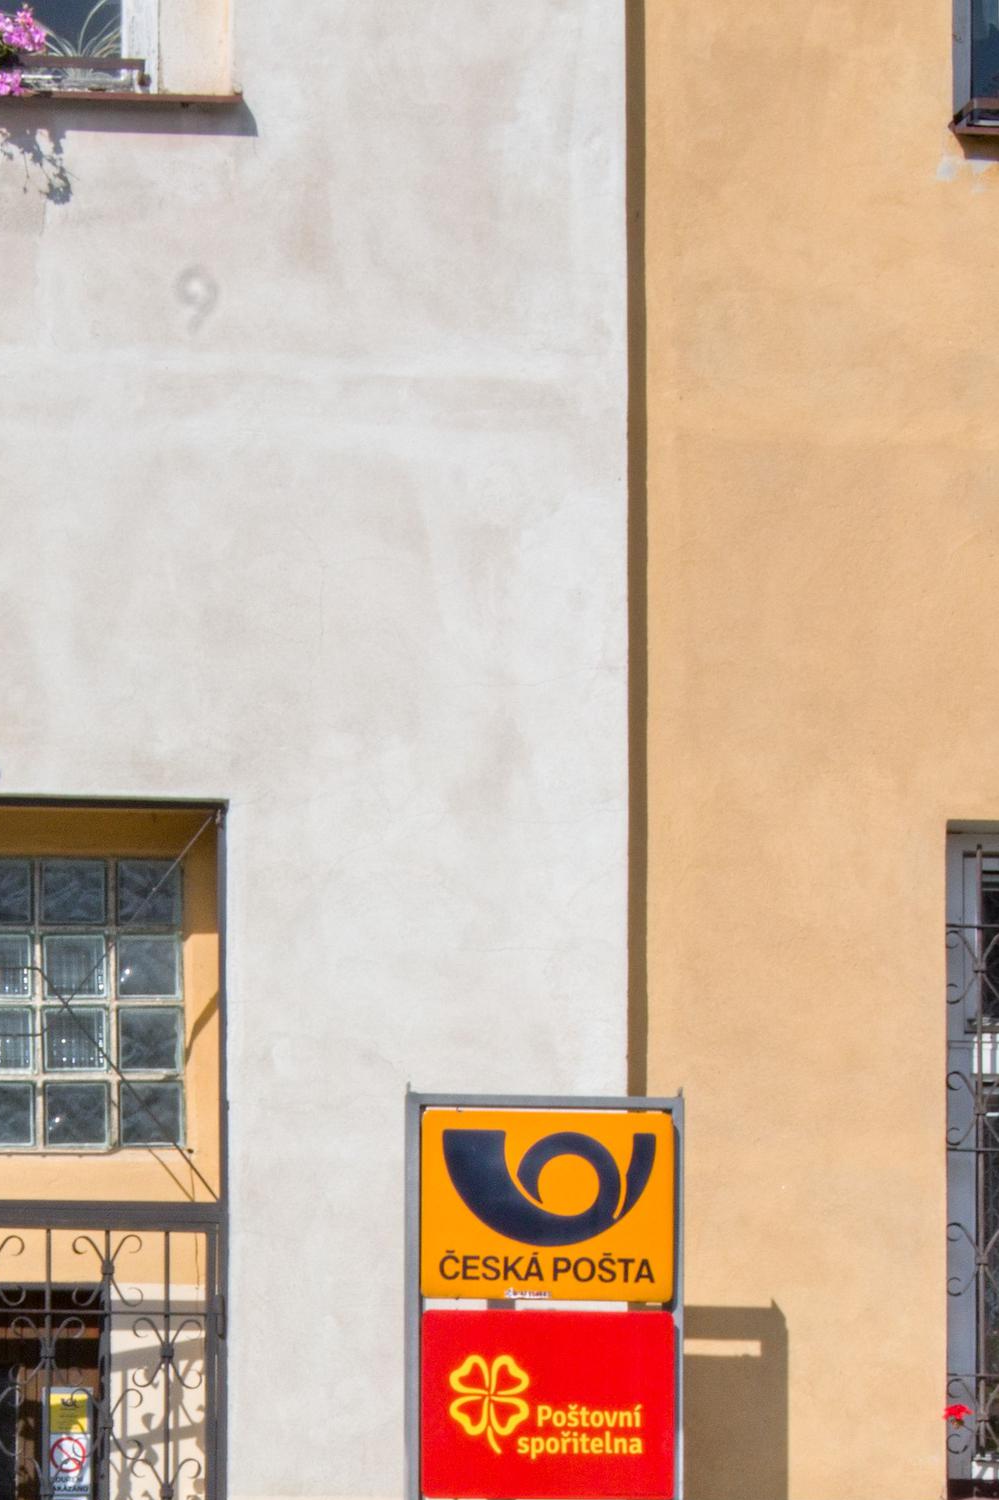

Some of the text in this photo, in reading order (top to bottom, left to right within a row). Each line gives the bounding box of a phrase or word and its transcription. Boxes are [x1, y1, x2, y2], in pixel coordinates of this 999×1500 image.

[438, 1250, 656, 1284] ČESKÁ POŠTA
[536, 1403, 643, 1428] Poštovní
[516, 1431, 644, 1461] spořitelna
